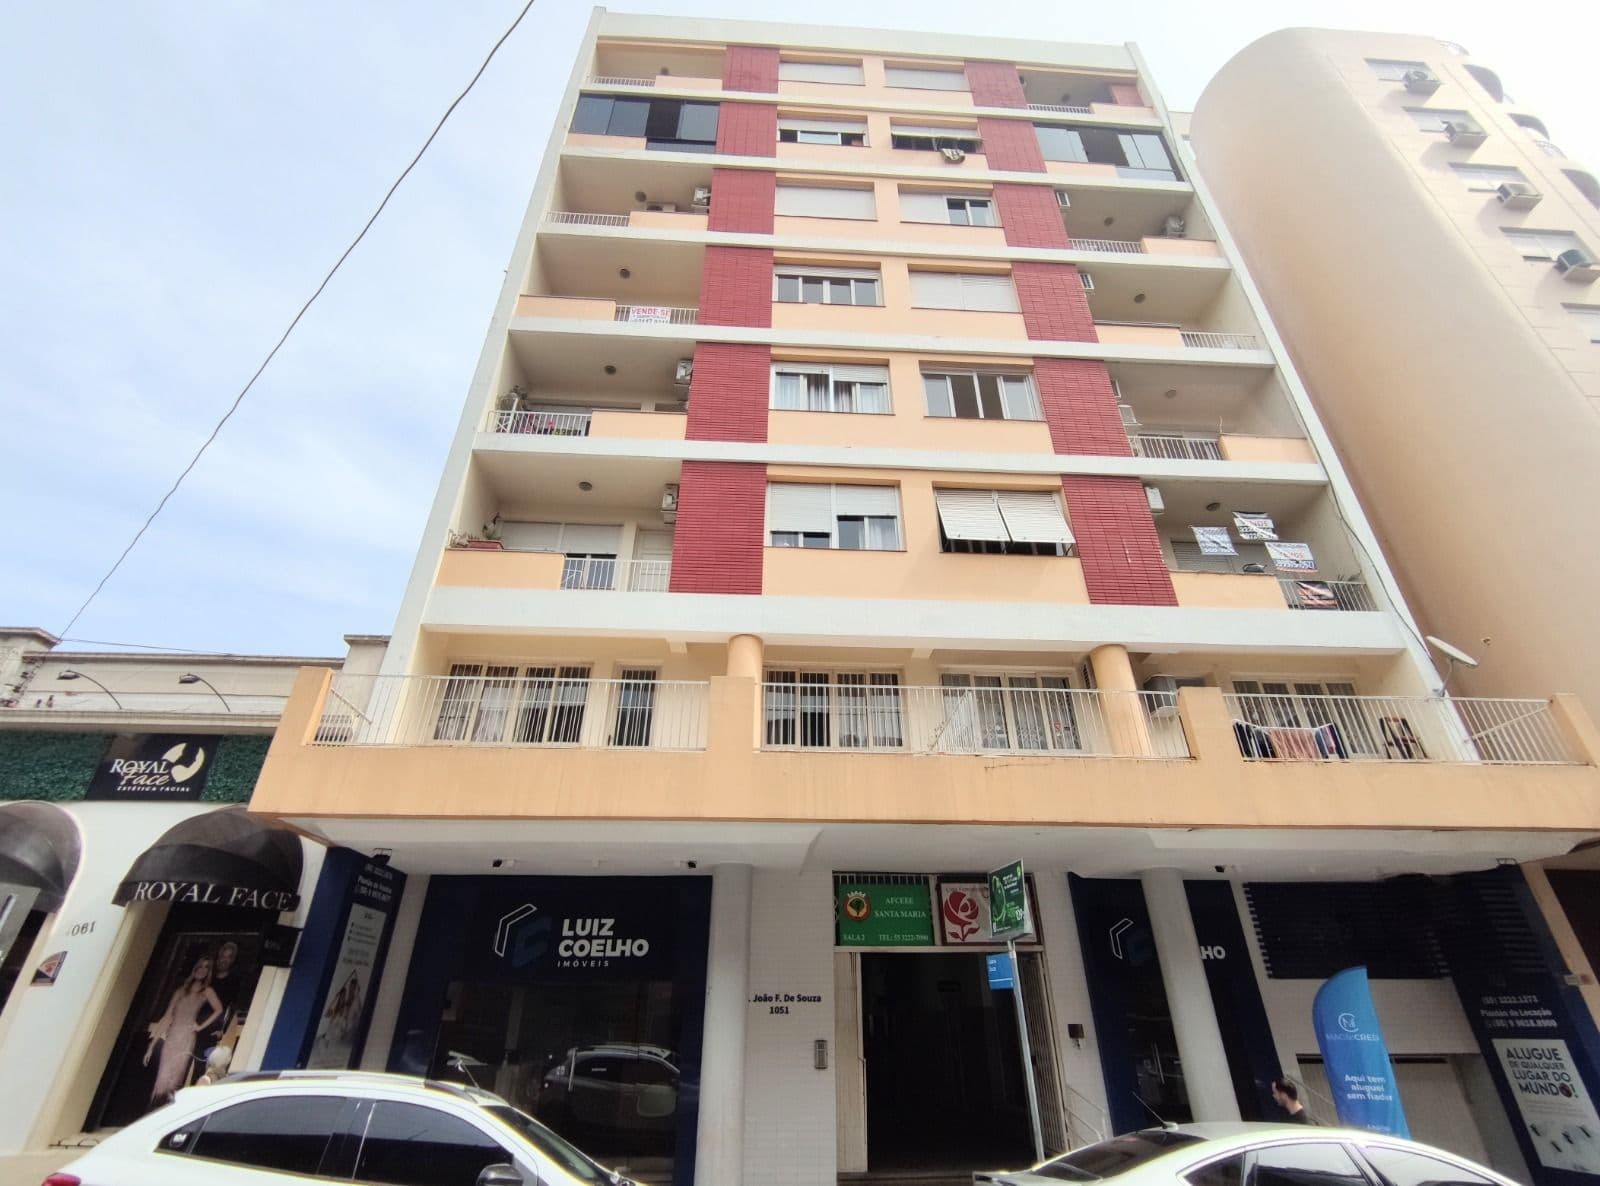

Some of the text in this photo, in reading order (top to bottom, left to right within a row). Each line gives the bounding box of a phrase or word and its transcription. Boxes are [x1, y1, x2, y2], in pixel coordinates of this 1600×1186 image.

[110, 758, 169, 774] ROYAL
[120, 767, 169, 785] Face
[133, 881, 292, 911] ROYAL FACE
[874, 910, 927, 918] SANTA MARIA
[66, 921, 96, 936] 061
[562, 918, 615, 937] LUIZ
[558, 939, 649, 957] COELHO
[557, 959, 609, 967] IMÓVEIS
[753, 993, 773, 1002] João
[775, 994, 782, 1002] F.
[784, 994, 795, 1002] De
[797, 993, 822, 1002] Souza
[769, 1006, 789, 1014] 1051
[1506, 1047, 1563, 1061] ALUGUE
[1508, 1061, 1566, 1071] DE QUALQUER
[1344, 1074, 1386, 1084] Aqui tem
[1513, 1070, 1572, 1083] LUGAR DO
[1351, 1083, 1385, 1095] aluguel
[1347, 1092, 1366, 1100] sem
